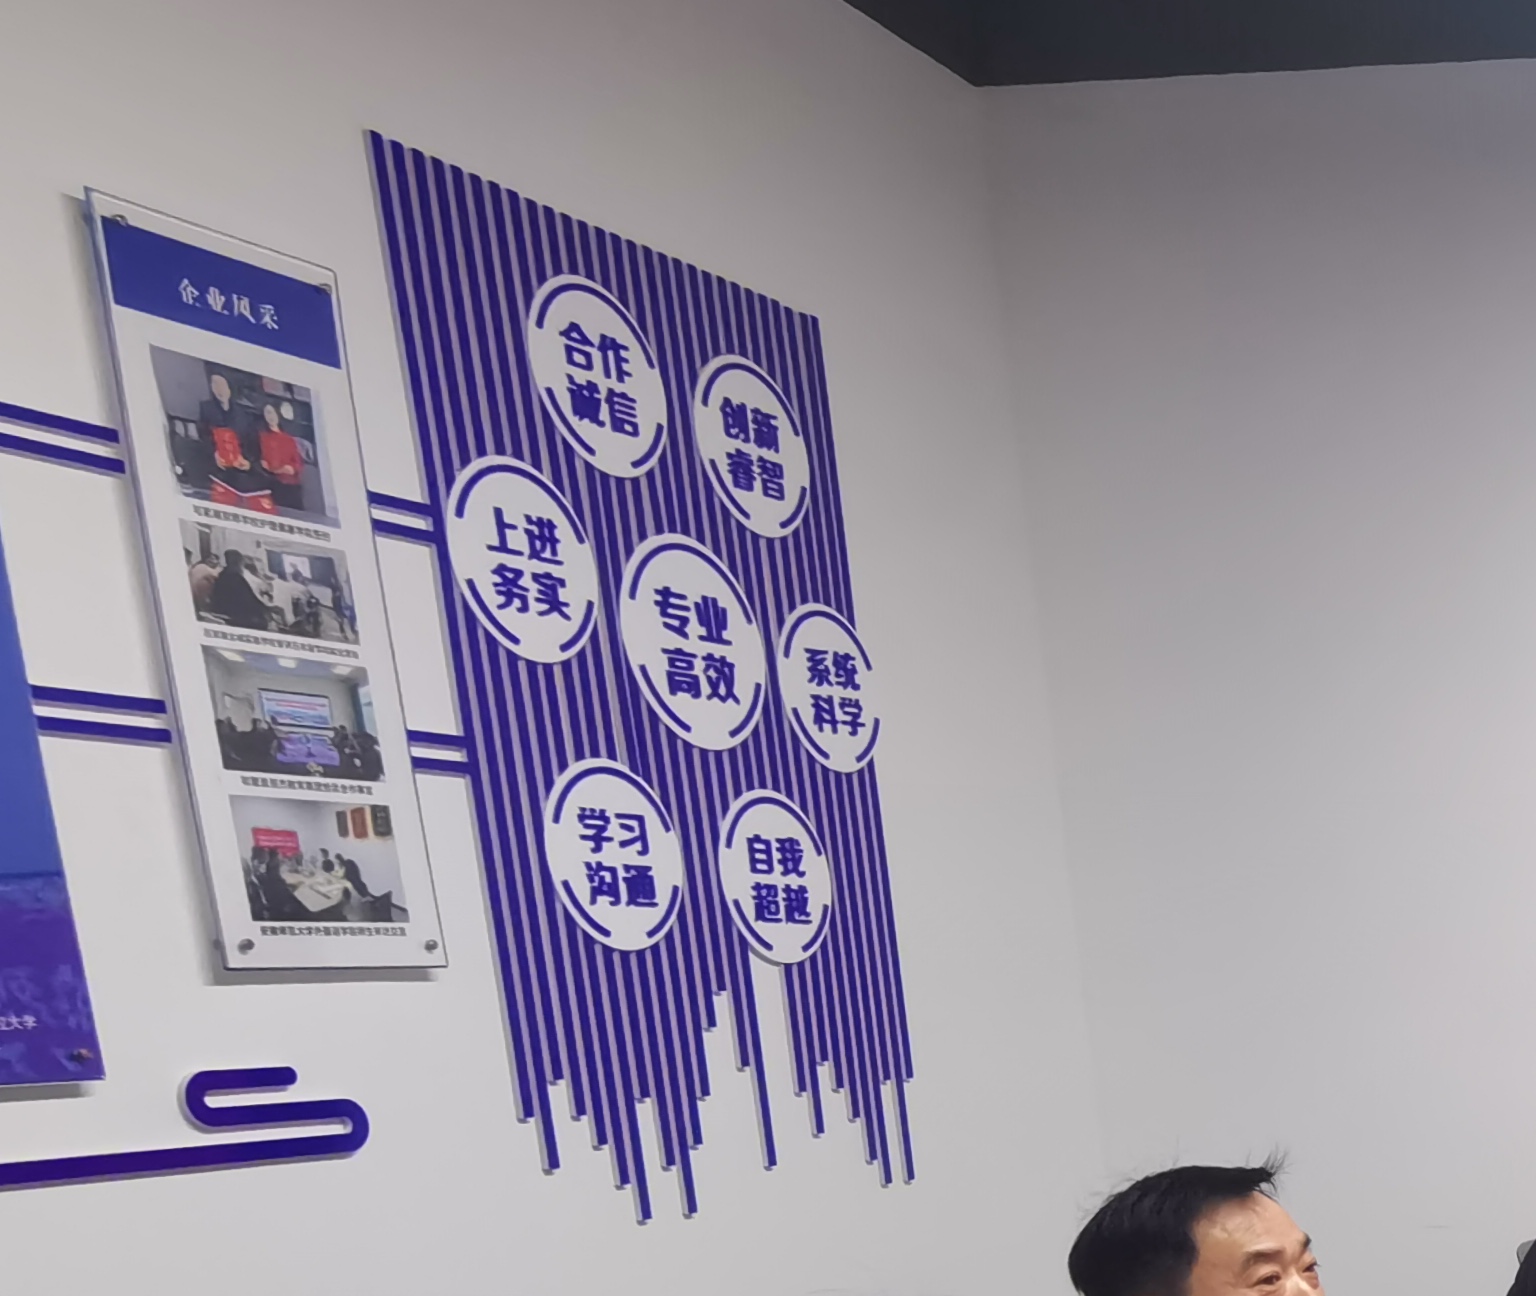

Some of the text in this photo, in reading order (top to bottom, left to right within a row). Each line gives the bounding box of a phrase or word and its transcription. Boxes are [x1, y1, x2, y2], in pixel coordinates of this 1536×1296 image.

[178, 278, 279, 330] 企业风采
[557, 320, 633, 383] 合作
[564, 374, 641, 438] 诚信
[718, 396, 781, 452] 创新
[726, 448, 786, 502] 睿智
[486, 506, 564, 567] 上进
[491, 563, 572, 621] 务实
[653, 586, 733, 647] 专业
[663, 647, 741, 705] 高效
[803, 647, 862, 693] 系统
[810, 693, 866, 737] 科学
[576, 807, 650, 857] 学习
[746, 835, 807, 878] 自我
[585, 861, 658, 909] 沟通
[750, 883, 812, 926] 超越
